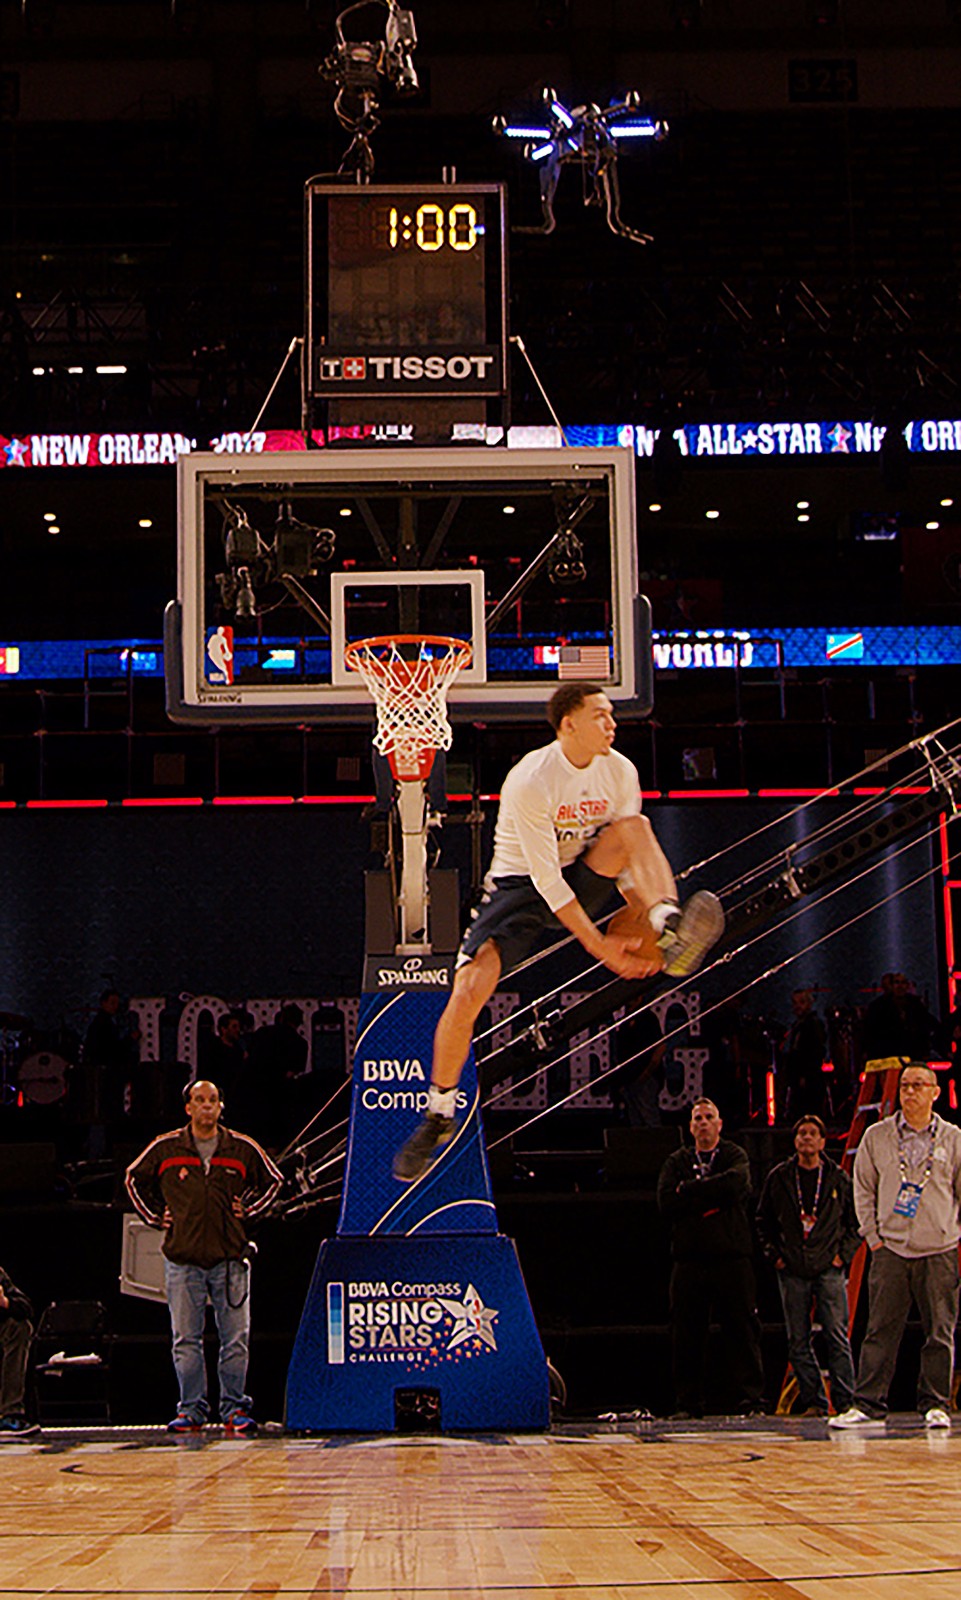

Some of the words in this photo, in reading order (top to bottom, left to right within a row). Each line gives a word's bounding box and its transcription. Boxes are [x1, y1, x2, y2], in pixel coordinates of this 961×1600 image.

[389, 204, 476, 250] 1:00
[368, 356, 493, 379] TISSOT
[31, 435, 91, 465] NEW
[98, 433, 197, 464] ORLEAN
[697, 424, 743, 455] ALL
[758, 423, 822, 454] STAR
[378, 969, 448, 986] SPALDING
[363, 1059, 426, 1082] BBVA
[361, 1087, 468, 1113] Comps
[348, 1283, 389, 1298] BBVA
[391, 1281, 462, 1299] Compass
[349, 1301, 443, 1326] RISING
[349, 1325, 433, 1349] STARS
[349, 1352, 422, 1363] CHALLENGE
